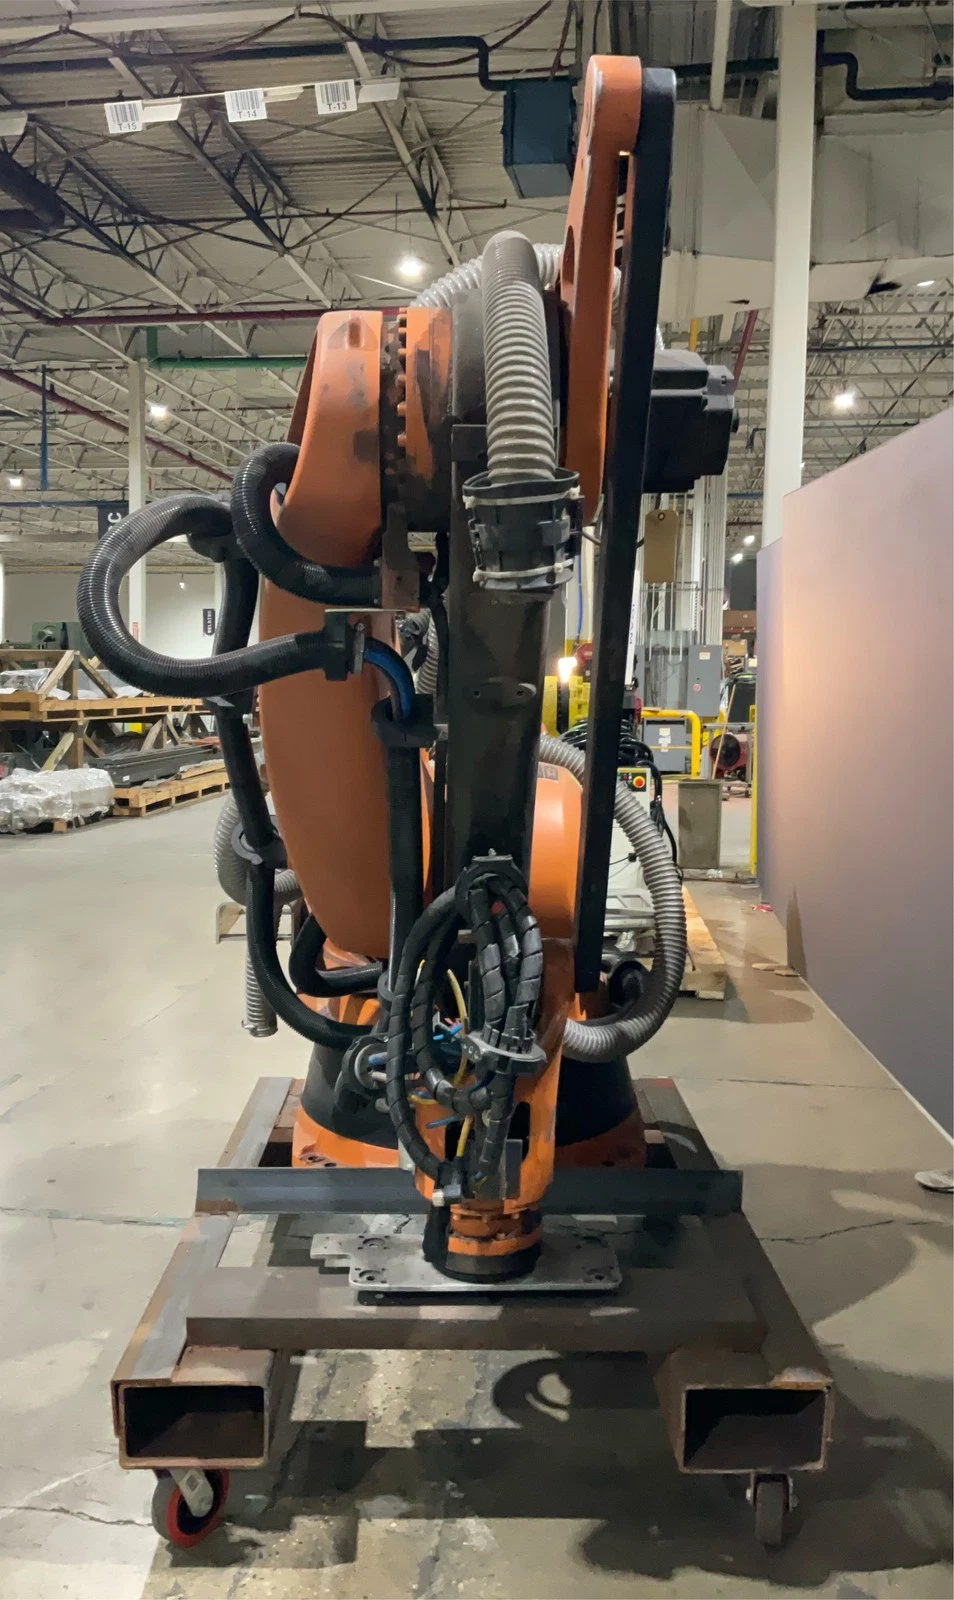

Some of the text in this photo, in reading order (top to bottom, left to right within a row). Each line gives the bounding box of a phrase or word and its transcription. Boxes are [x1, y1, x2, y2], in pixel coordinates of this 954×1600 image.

[326, 101, 347, 111] T-13
[237, 109, 257, 119] T-14
[117, 122, 137, 131] T-15
[107, 512, 121, 531] C
